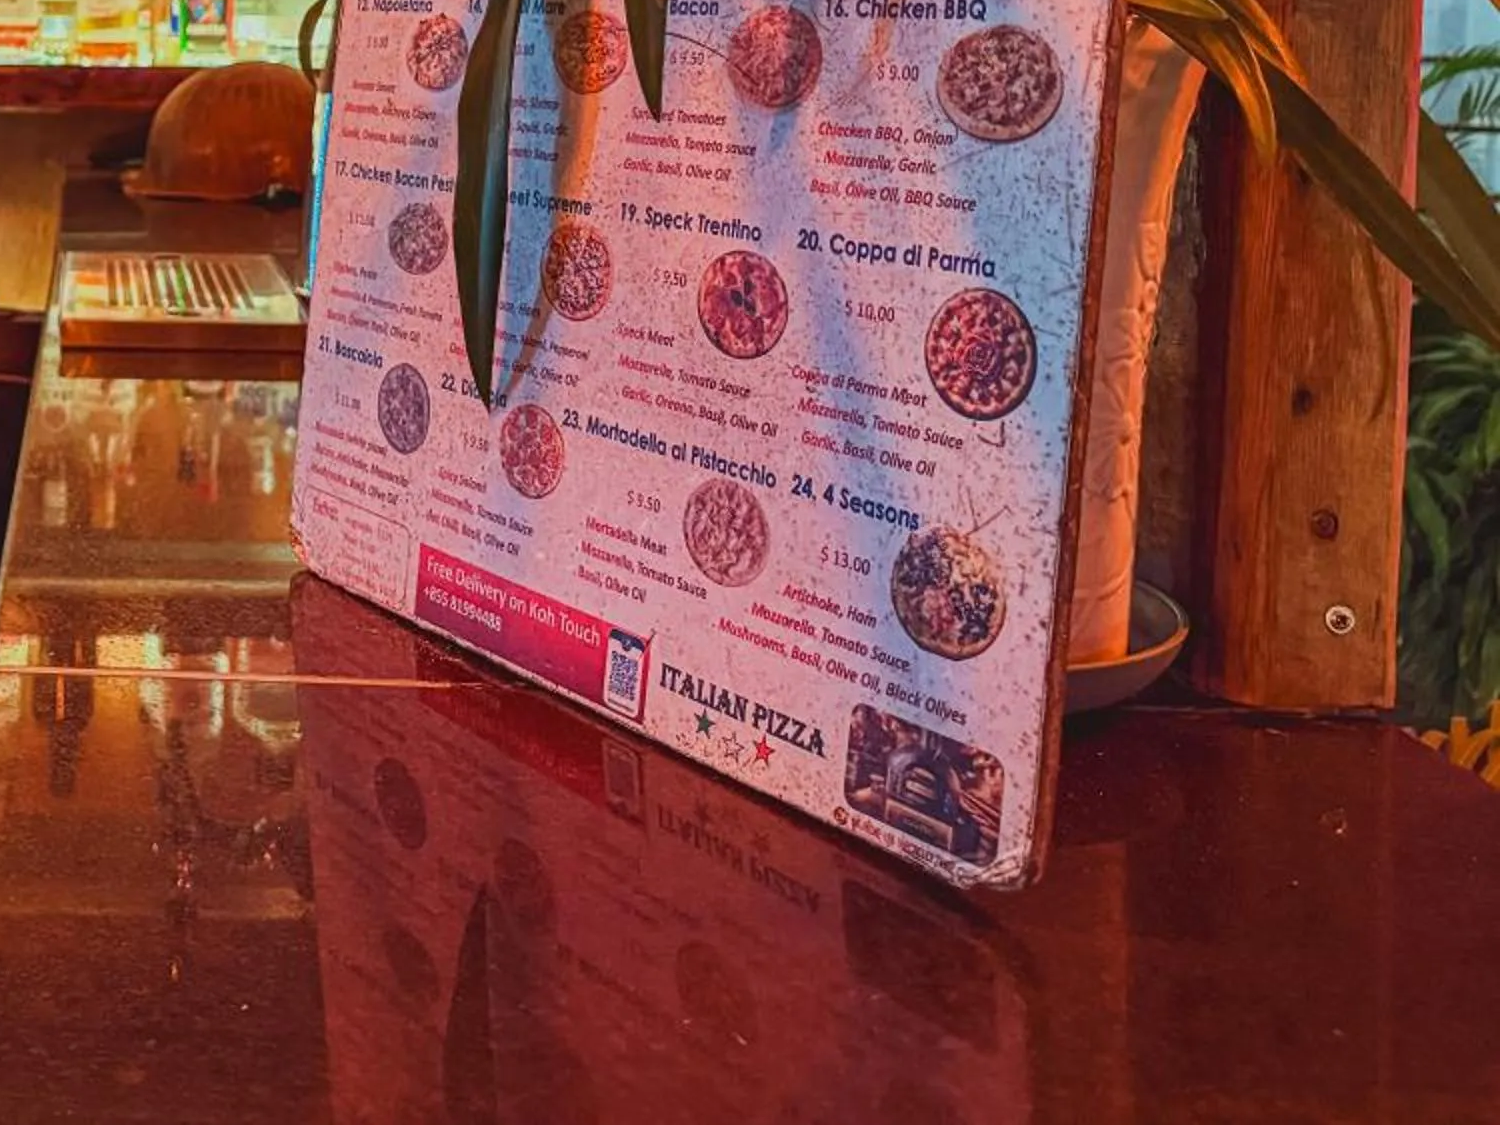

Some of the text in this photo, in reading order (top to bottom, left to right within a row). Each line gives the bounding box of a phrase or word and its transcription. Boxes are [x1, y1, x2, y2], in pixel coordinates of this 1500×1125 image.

[888, 64, 920, 82] 9.00
[913, 126, 954, 146] Onion
[335, 160, 350, 177] 17.
[351, 165, 393, 184] Chicken
[395, 170, 430, 189] Bacon
[685, 163, 712, 180] Olive
[713, 165, 732, 182] Oil
[898, 153, 937, 175] Garlic
[532, 190, 593, 216] Supreme
[845, 180, 876, 200] Olive
[904, 187, 934, 208] BBQ
[936, 193, 977, 213] Sauce
[620, 202, 763, 243] 19. Speck Trentino
[796, 228, 996, 278] 20. Coppa di Parma
[856, 302, 896, 323] 10.00
[718, 378, 751, 398] Sauce
[791, 363, 830, 387] Coppa
[846, 374, 888, 400] Parma
[891, 384, 928, 409] Meat
[729, 412, 760, 432] Olive
[760, 420, 778, 437] Oil
[797, 396, 964, 451] Mozzarella, Tomato Sauce
[562, 408, 777, 489] 23. Mortadella al Pistacchio
[801, 429, 841, 455] Garlic,
[879, 449, 914, 473] Olive
[915, 458, 936, 478] Oil
[790, 474, 921, 531] 24. 4 Seasons
[640, 534, 668, 557] Meat
[833, 549, 871, 576] 13.00
[422, 586, 449, 607] +855
[637, 560, 675, 587] Tomato
[677, 574, 708, 600] Sauce
[426, 555, 453, 582] Free
[454, 566, 508, 608] Delivery
[509, 595, 526, 614] on
[528, 599, 555, 626] Koh
[558, 610, 601, 648] Touch
[782, 584, 878, 629] Artichoke, Ham
[820, 626, 869, 658] Tomato
[869, 644, 911, 673] Sauce
[718, 617, 789, 657] Mushrooms,
[825, 658, 858, 684] Olive
[885, 681, 923, 710] Black
[924, 696, 968, 727] Olives
[658, 661, 828, 759] ITALIAN PIZZA
